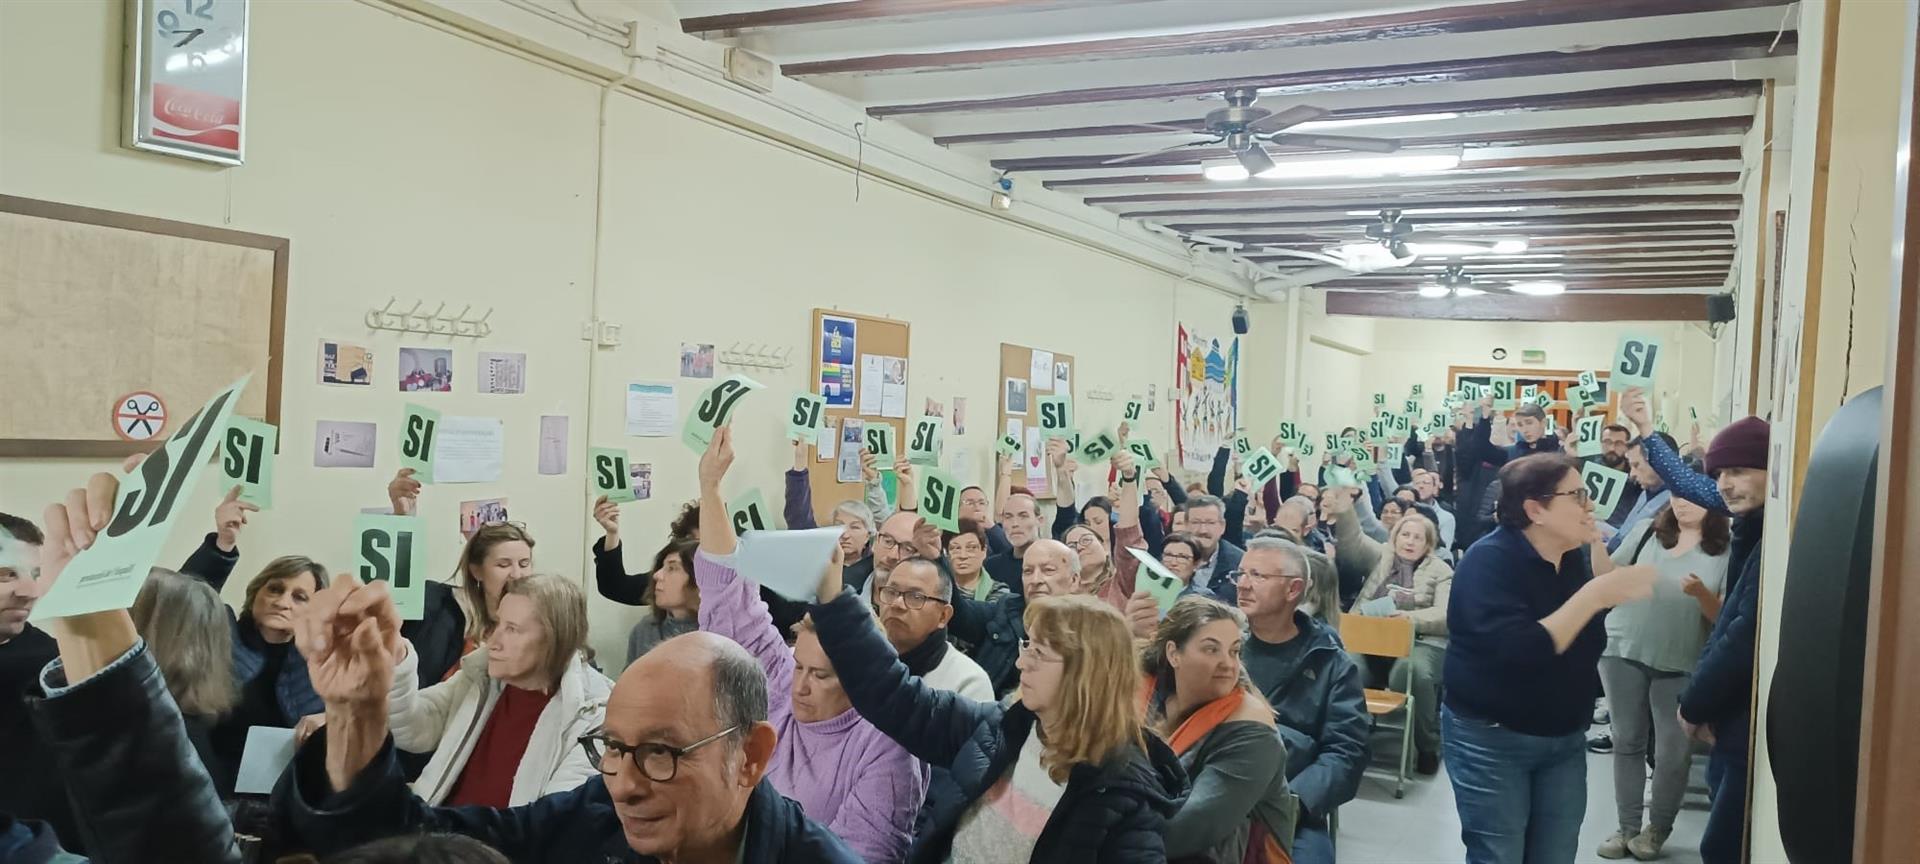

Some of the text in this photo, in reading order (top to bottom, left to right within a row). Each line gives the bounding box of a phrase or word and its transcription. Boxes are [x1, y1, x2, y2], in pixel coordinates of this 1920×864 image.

[157, 10, 179, 38] 9
[1620, 340, 1658, 378] SI
[1412, 384, 1422, 394] SI
[1495, 381, 1511, 400] SI
[1581, 373, 1594, 386] SI
[698, 380, 751, 428] SI
[1374, 393, 1384, 404] SI
[1464, 385, 1475, 400] SI
[1525, 388, 1535, 397] SI
[793, 397, 821, 429] SI
[1041, 402, 1067, 429] SI
[1125, 401, 1141, 420] SI
[1406, 401, 1417, 412] SI
[1281, 422, 1295, 439] SI
[1370, 421, 1383, 437] SI
[1396, 416, 1408, 430] SI
[1434, 414, 1445, 427] SI
[1580, 420, 1598, 443] SI
[403, 414, 435, 462] SI
[867, 429, 888, 454] SI
[911, 421, 936, 452] SI
[1084, 434, 1114, 458] SI
[1237, 437, 1250, 453] SI
[1326, 435, 1338, 449] SI
[107, 389, 234, 538] SI
[224, 427, 264, 484] SI
[1387, 446, 1398, 460] SI
[596, 454, 627, 489] SI
[1249, 455, 1276, 481] SI
[924, 476, 955, 520] SI
[1585, 471, 1616, 506] SI
[360, 528, 412, 588] SI
